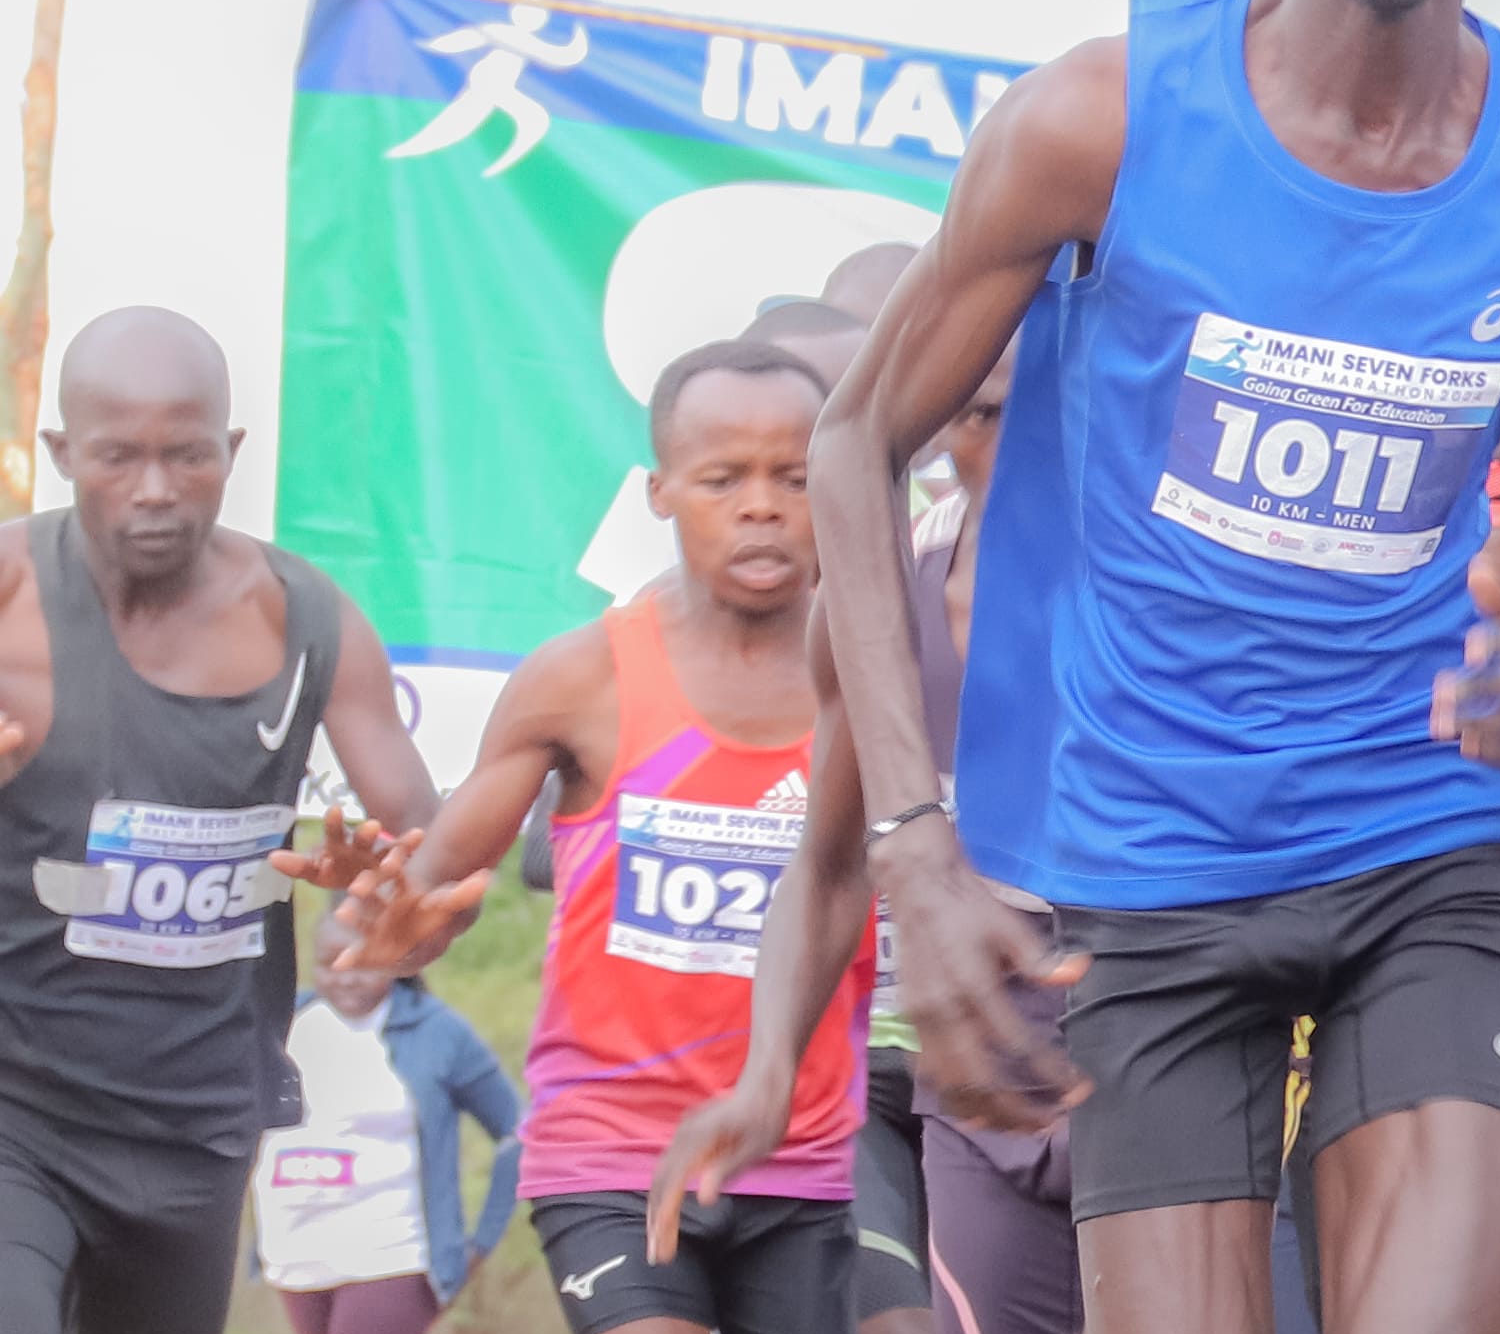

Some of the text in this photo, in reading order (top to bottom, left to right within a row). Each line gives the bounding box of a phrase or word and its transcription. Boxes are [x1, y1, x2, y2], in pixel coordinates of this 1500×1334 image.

[700, 35, 1034, 157] IMA
[1259, 358, 1312, 378] HALF
[1322, 371, 1436, 402] MARATHON
[1265, 338, 1488, 389] IMANI SEVEN FORKS
[1242, 376, 1447, 425] Going Green For Education
[1211, 399, 1425, 514] 1011
[1250, 494, 1272, 512] 10
[1277, 502, 1309, 521] KM
[1332, 511, 1377, 531] MEN
[629, 853, 782, 931] 102
